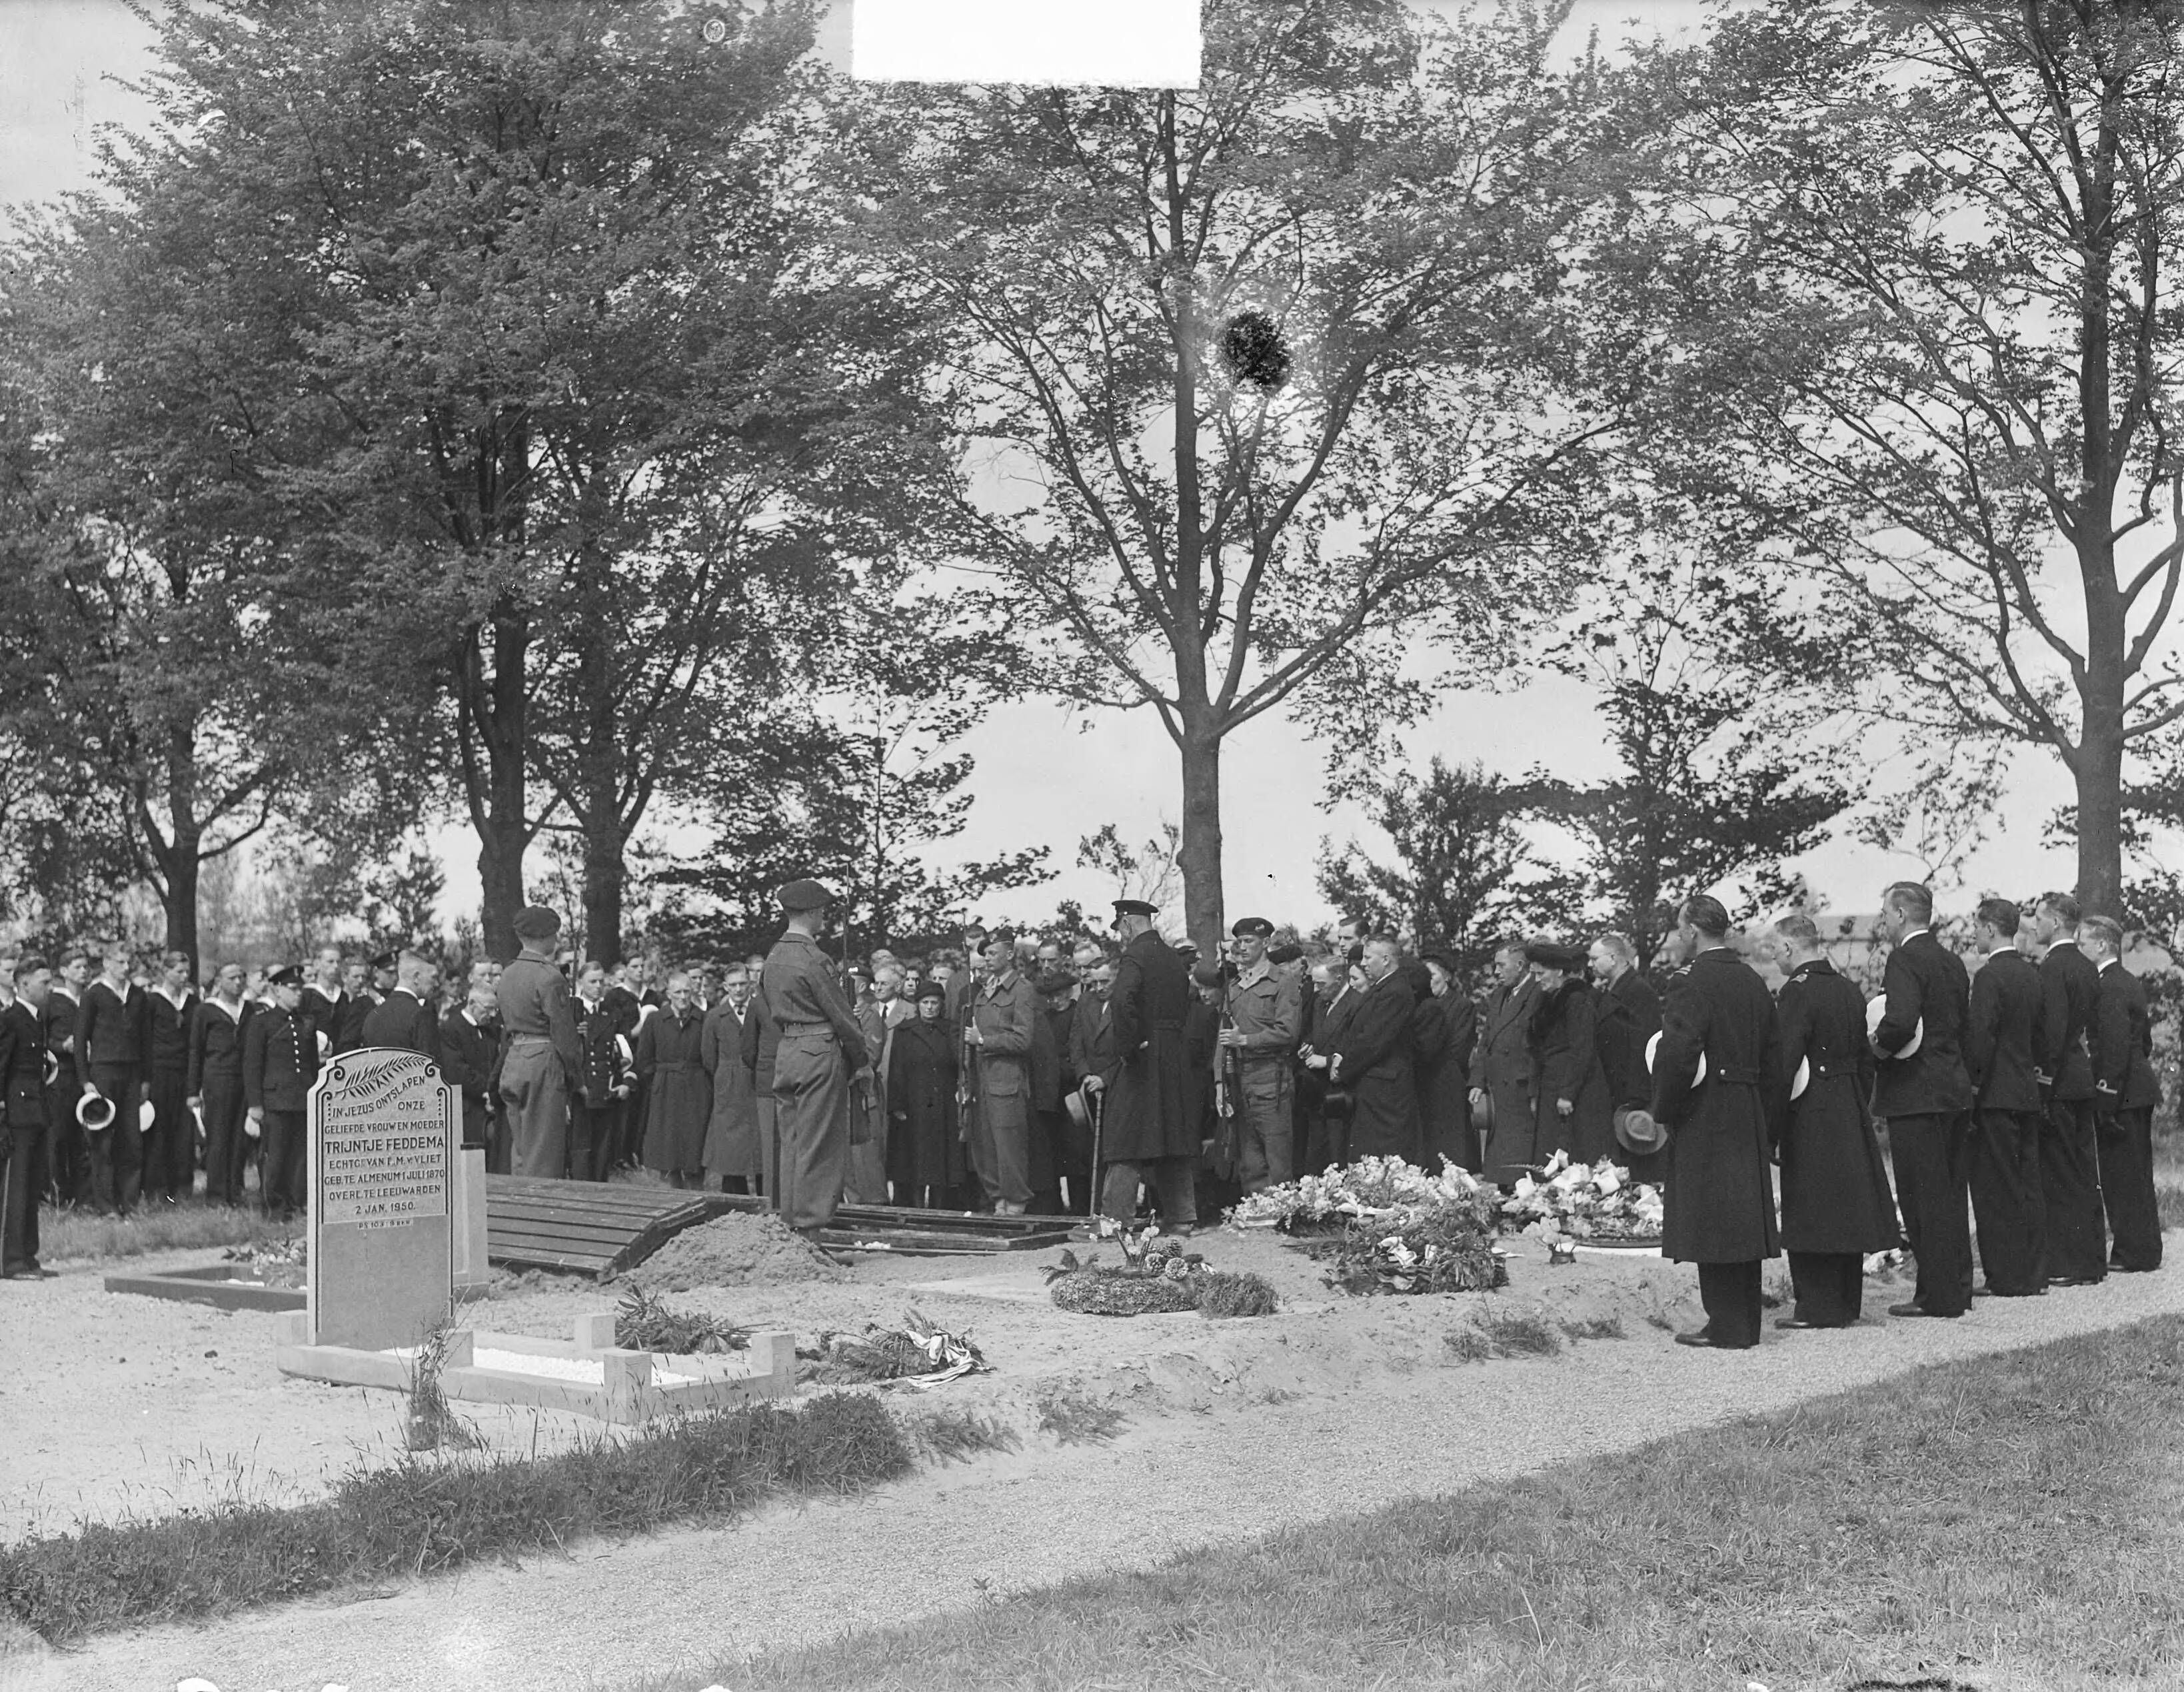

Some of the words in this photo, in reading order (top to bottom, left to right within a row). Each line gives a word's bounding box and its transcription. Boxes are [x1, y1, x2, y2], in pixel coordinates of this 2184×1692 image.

[333, 1108, 343, 1118] IN
[345, 1102, 374, 1117] JEZUS
[375, 1076, 425, 1110] ONTSLAPEN
[398, 1101, 425, 1110] ONZE
[325, 1124, 364, 1134] GELIEFDE
[410, 1120, 444, 1130] MOEDER
[325, 1139, 383, 1154] TRIJNTJE
[386, 1136, 444, 1151] FEDDEMA
[366, 1157, 384, 1167] VAN
[414, 1154, 441, 1164] VLIET
[344, 1175, 355, 1184] TE
[357, 1172, 400, 1184] ALMENUM
[407, 1170, 425, 1180] JULI
[426, 1169, 445, 1179] 1870
[363, 1189, 375, 1198] TE
[377, 1184, 441, 1197] LEEUWARDEN
[355, 1206, 361, 1215] 2
[365, 1204, 387, 1214] JAN.
